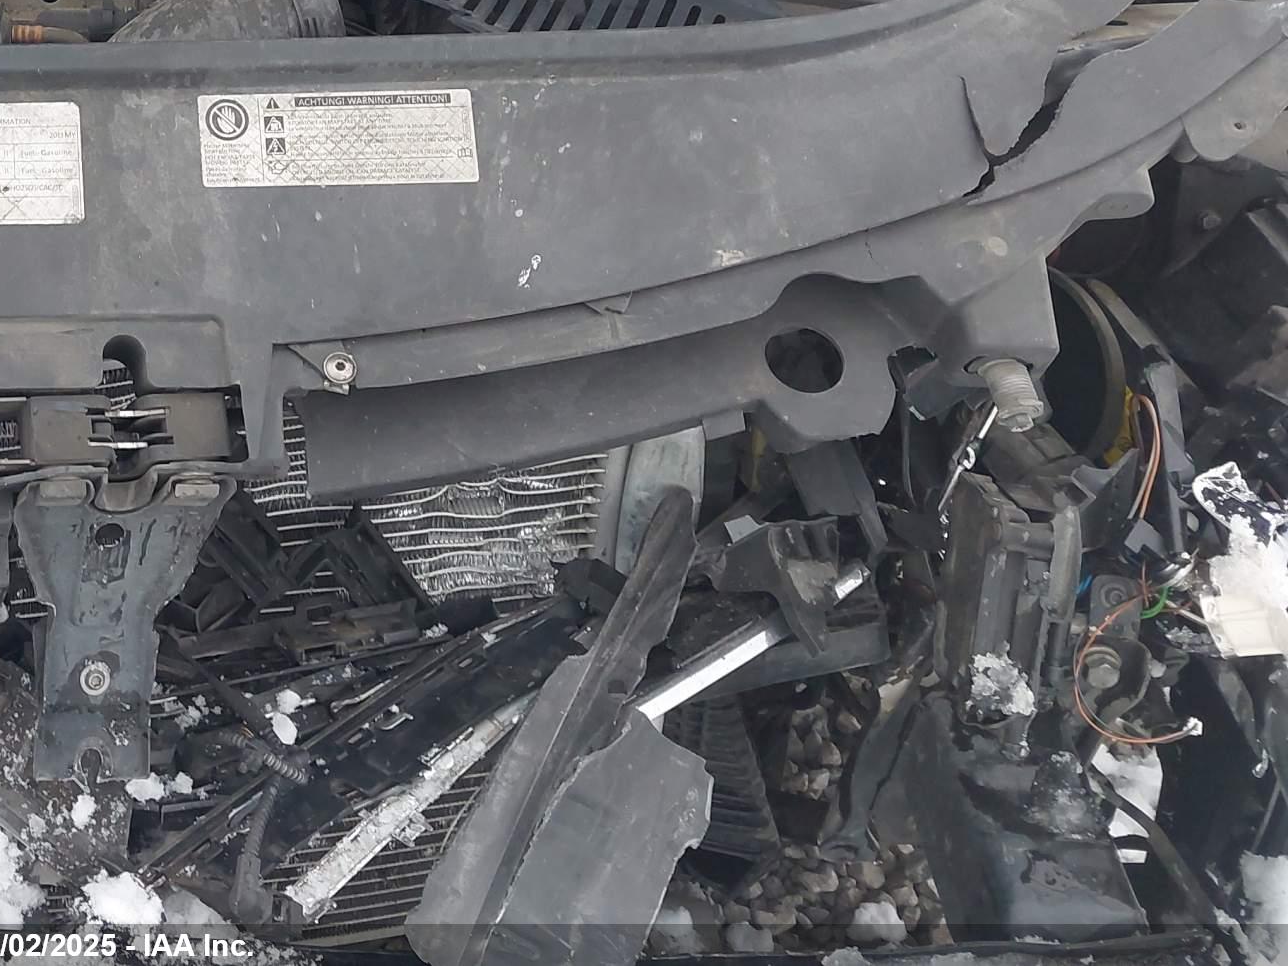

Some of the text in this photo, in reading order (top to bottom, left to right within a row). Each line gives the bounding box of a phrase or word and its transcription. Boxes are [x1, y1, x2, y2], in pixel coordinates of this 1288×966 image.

[297, 94, 449, 107] ACHTUNG! WARNING! ATTENTION!
